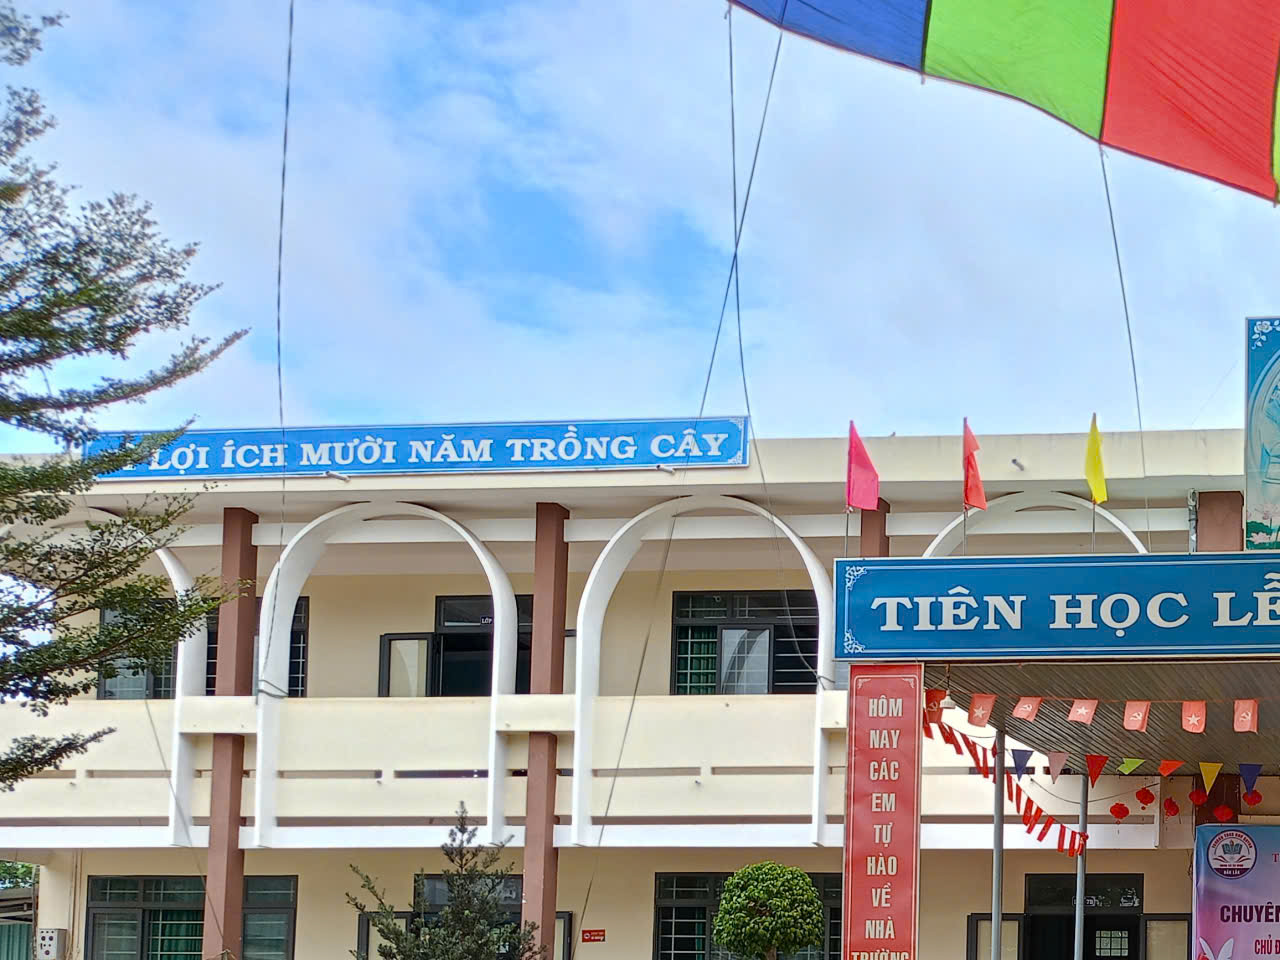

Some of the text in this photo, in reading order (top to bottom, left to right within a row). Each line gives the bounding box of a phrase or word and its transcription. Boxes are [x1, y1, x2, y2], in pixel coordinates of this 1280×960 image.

[149, 444, 210, 474] LỢI
[221, 439, 287, 468] ÍCH
[300, 435, 397, 466] MƯỜI
[408, 433, 493, 463] NĂM
[506, 425, 638, 462] TRỒNG
[650, 428, 729, 457] CÂY
[871, 585, 1027, 631] TIÊN
[1049, 591, 1189, 637] HỌC
[868, 694, 903, 717] HÔM
[870, 730, 900, 749] NAY
[870, 758, 899, 781] CÁC
[872, 793, 896, 812] EM
[874, 822, 893, 847] TỰ
[866, 853, 897, 875] HÀO
[871, 882, 891, 907] VỀ
[865, 916, 895, 939] NHÀ
[1254, 934, 1272, 955] CHỦ
